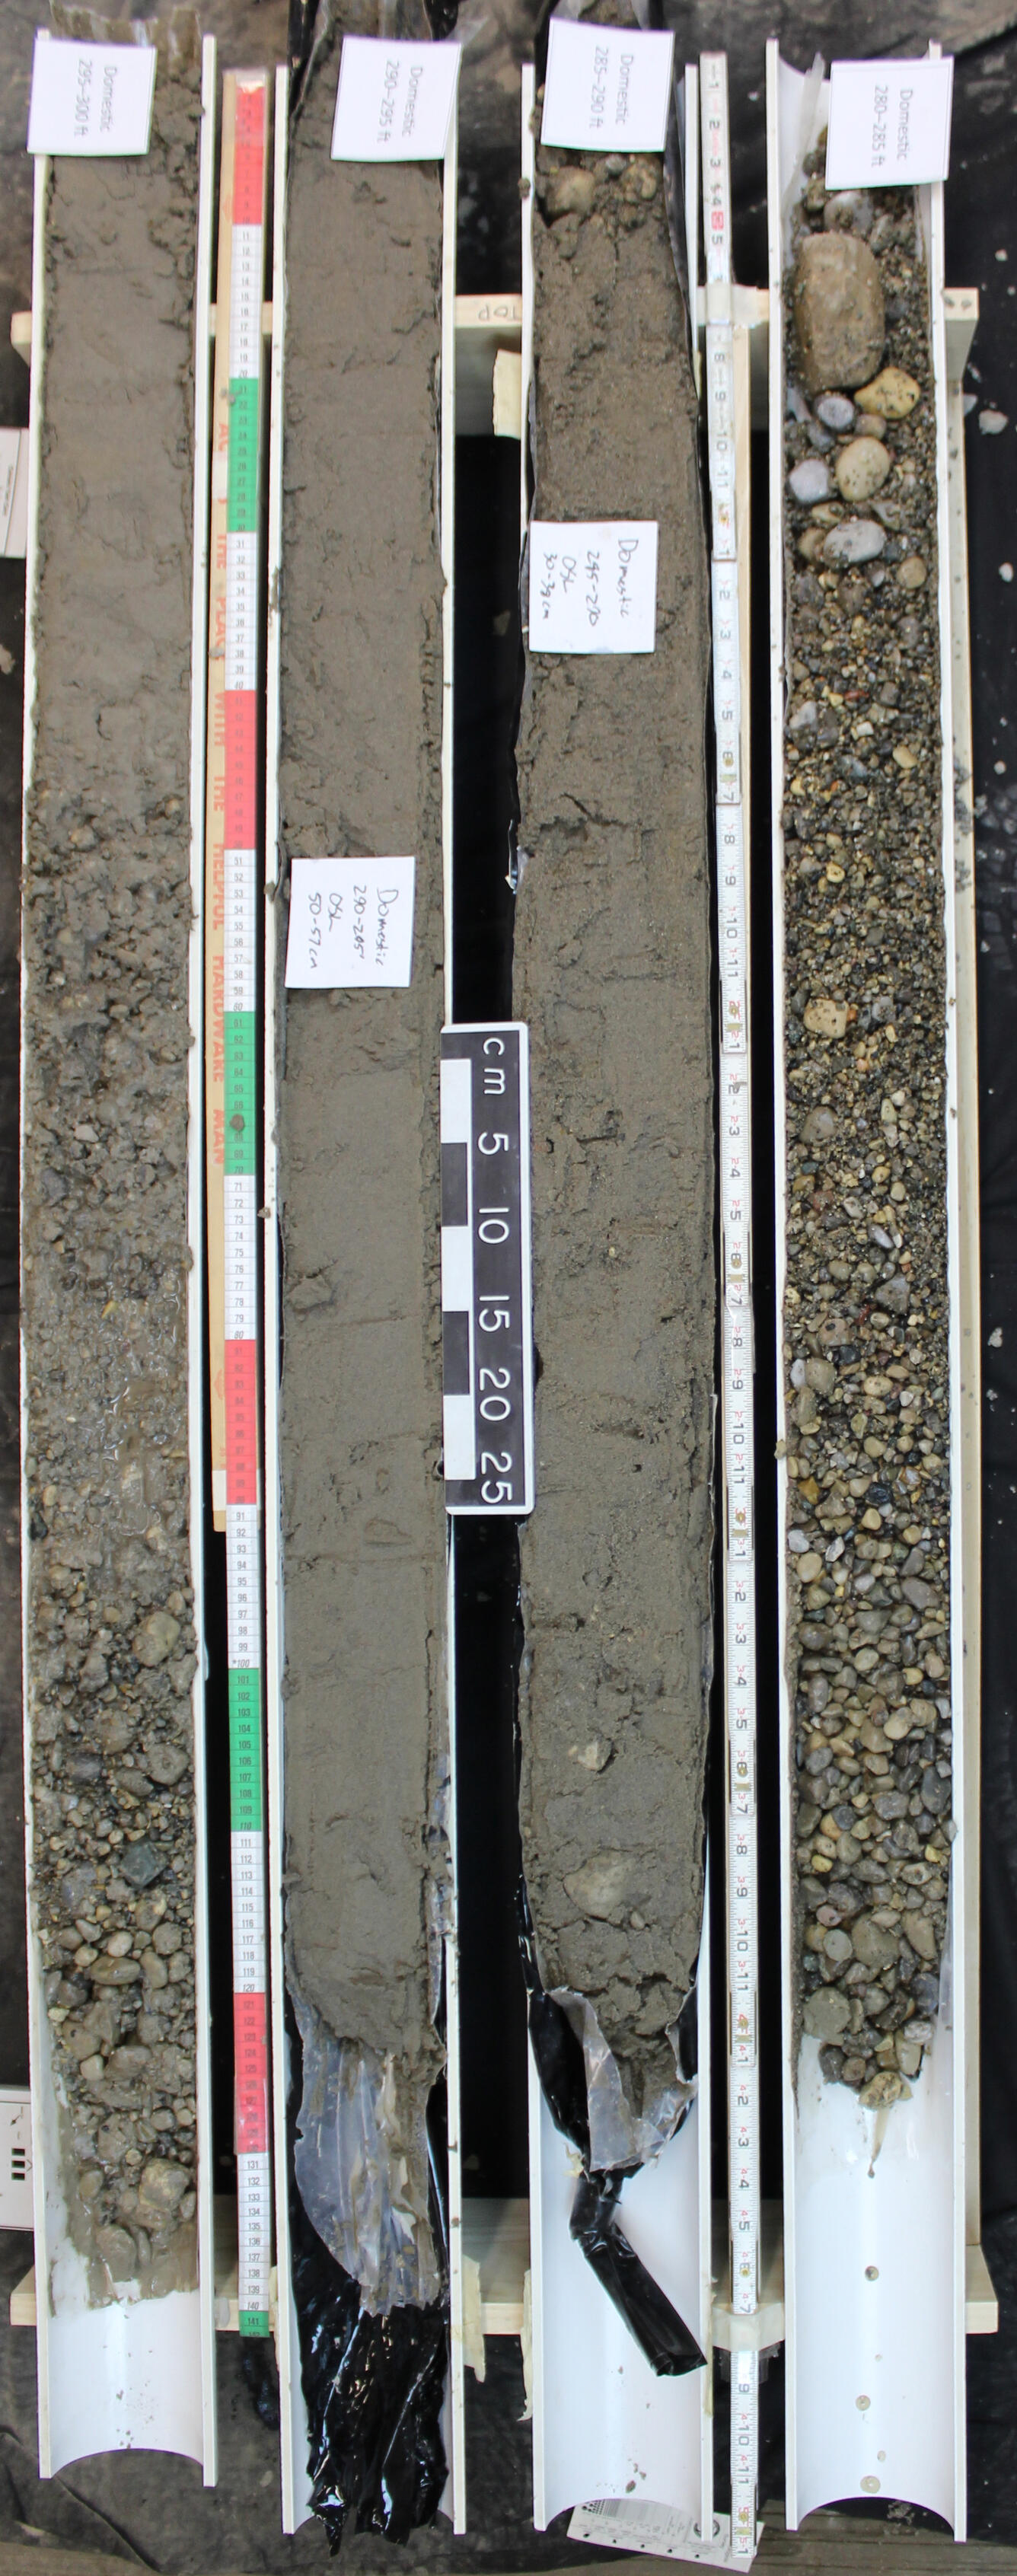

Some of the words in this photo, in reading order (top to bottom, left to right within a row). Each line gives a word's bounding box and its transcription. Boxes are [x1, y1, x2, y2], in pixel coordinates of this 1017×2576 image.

[616, 54, 634, 124] Domestic
[100, 66, 117, 132] Domestic
[402, 65, 422, 137] Domestic
[589, 117, 604, 129] ft
[709, 120, 721, 130] 2
[897, 89, 913, 161] Domestic
[75, 126, 88, 138] ft
[378, 131, 391, 143] ft
[710, 158, 722, 168] 3
[872, 156, 885, 167] ft
[712, 234, 723, 245] 5
[716, 431, 728, 451] 10
[616, 538, 639, 618] Domestic
[375, 887, 400, 966] Domestic
[478, 1132, 509, 1156] 5
[235, 1182, 242, 1191] 71
[235, 1199, 243, 1207] 72
[235, 1216, 244, 1224] 73
[478, 1207, 509, 1245] 10
[235, 1248, 244, 1257] 75
[236, 1281, 244, 1290] 77
[236, 1298, 244, 1306] 78
[479, 1294, 510, 1332] 15
[479, 1368, 511, 1422] 20
[480, 1452, 513, 1503] 25
[237, 1512, 244, 1520] 91
[237, 1529, 246, 1537] 92
[237, 1545, 246, 1553] 93
[238, 1577, 247, 1586] 95
[238, 1610, 247, 1618] 97
[239, 1643, 247, 1651] 99
[241, 1855, 251, 1863] 112
[241, 1871, 252, 1879] 113
[247, 2177, 260, 2185] 132
